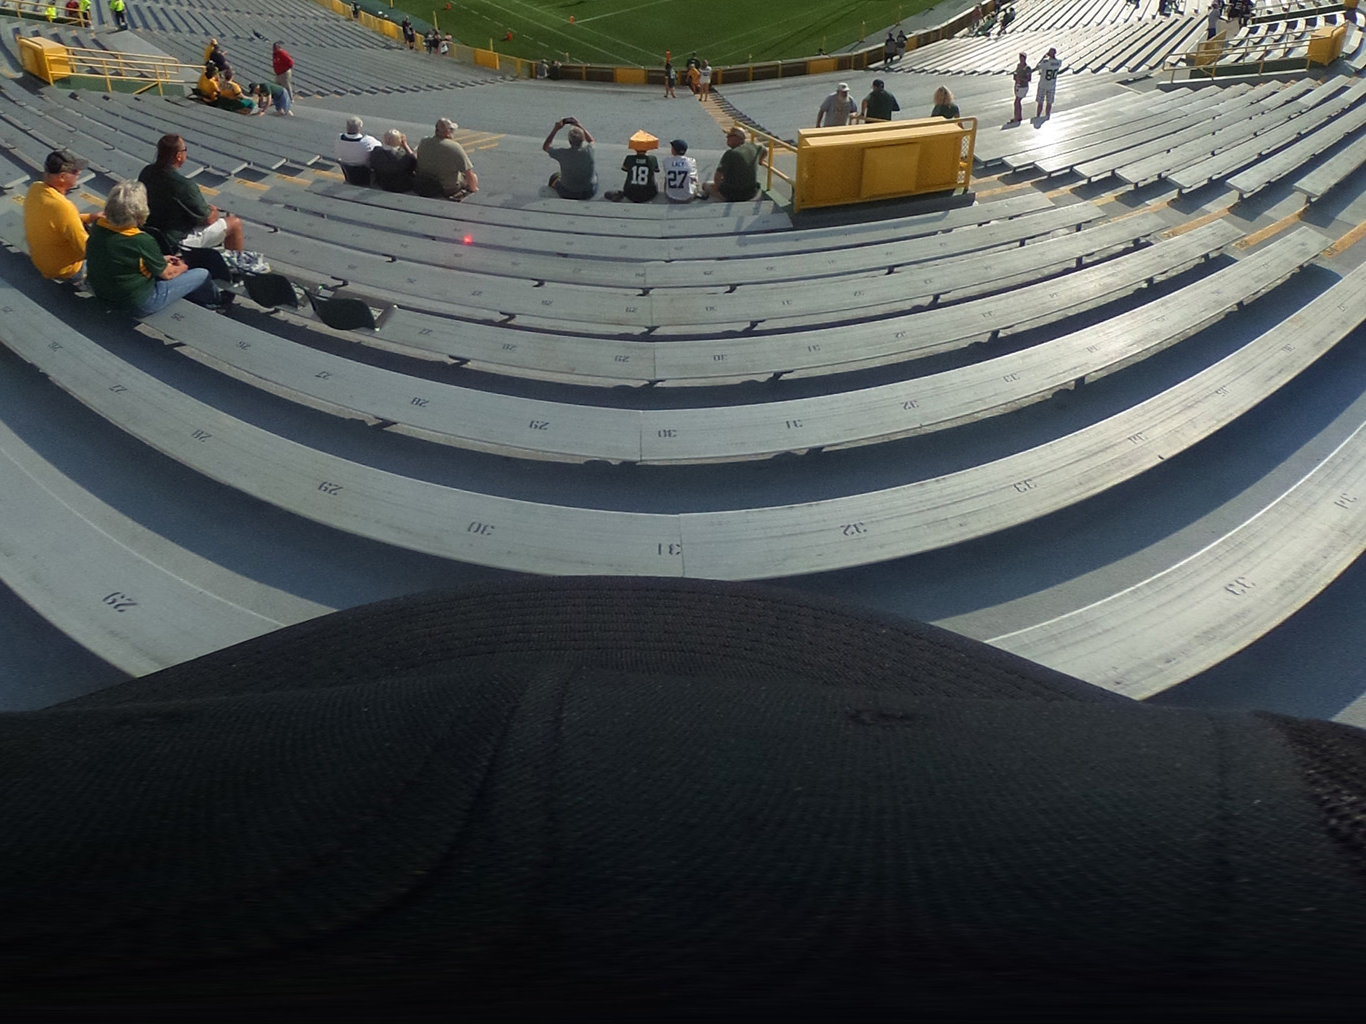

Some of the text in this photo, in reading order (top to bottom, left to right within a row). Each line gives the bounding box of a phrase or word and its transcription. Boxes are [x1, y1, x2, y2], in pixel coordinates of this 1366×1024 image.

[631, 165, 649, 185] 18
[667, 170, 688, 189] 27
[170, 312, 186, 322] 25
[980, 310, 997, 319] 33
[417, 327, 434, 337] 27
[47, 340, 64, 353] 26
[236, 341, 252, 351] 26
[1085, 342, 1102, 354] 34
[1279, 343, 1296, 353] 36
[614, 355, 631, 363] 29
[712, 354, 728, 362] 30
[315, 370, 332, 381] 27
[1002, 372, 1021, 383] 33
[108, 384, 128, 395] 27
[410, 396, 430, 408] 28
[899, 399, 920, 411] 32
[528, 420, 550, 431] 29
[785, 419, 803, 429] 31
[191, 429, 212, 443] 28
[657, 429, 677, 438] 30
[1126, 428, 1149, 445] 34
[317, 481, 343, 496] 29
[1010, 478, 1037, 493] 33
[1333, 492, 1358, 510] 34
[467, 521, 495, 536] 30
[839, 521, 868, 536] 32
[657, 543, 683, 556] 31
[1223, 576, 1256, 596] 33
[102, 591, 137, 613] 29
